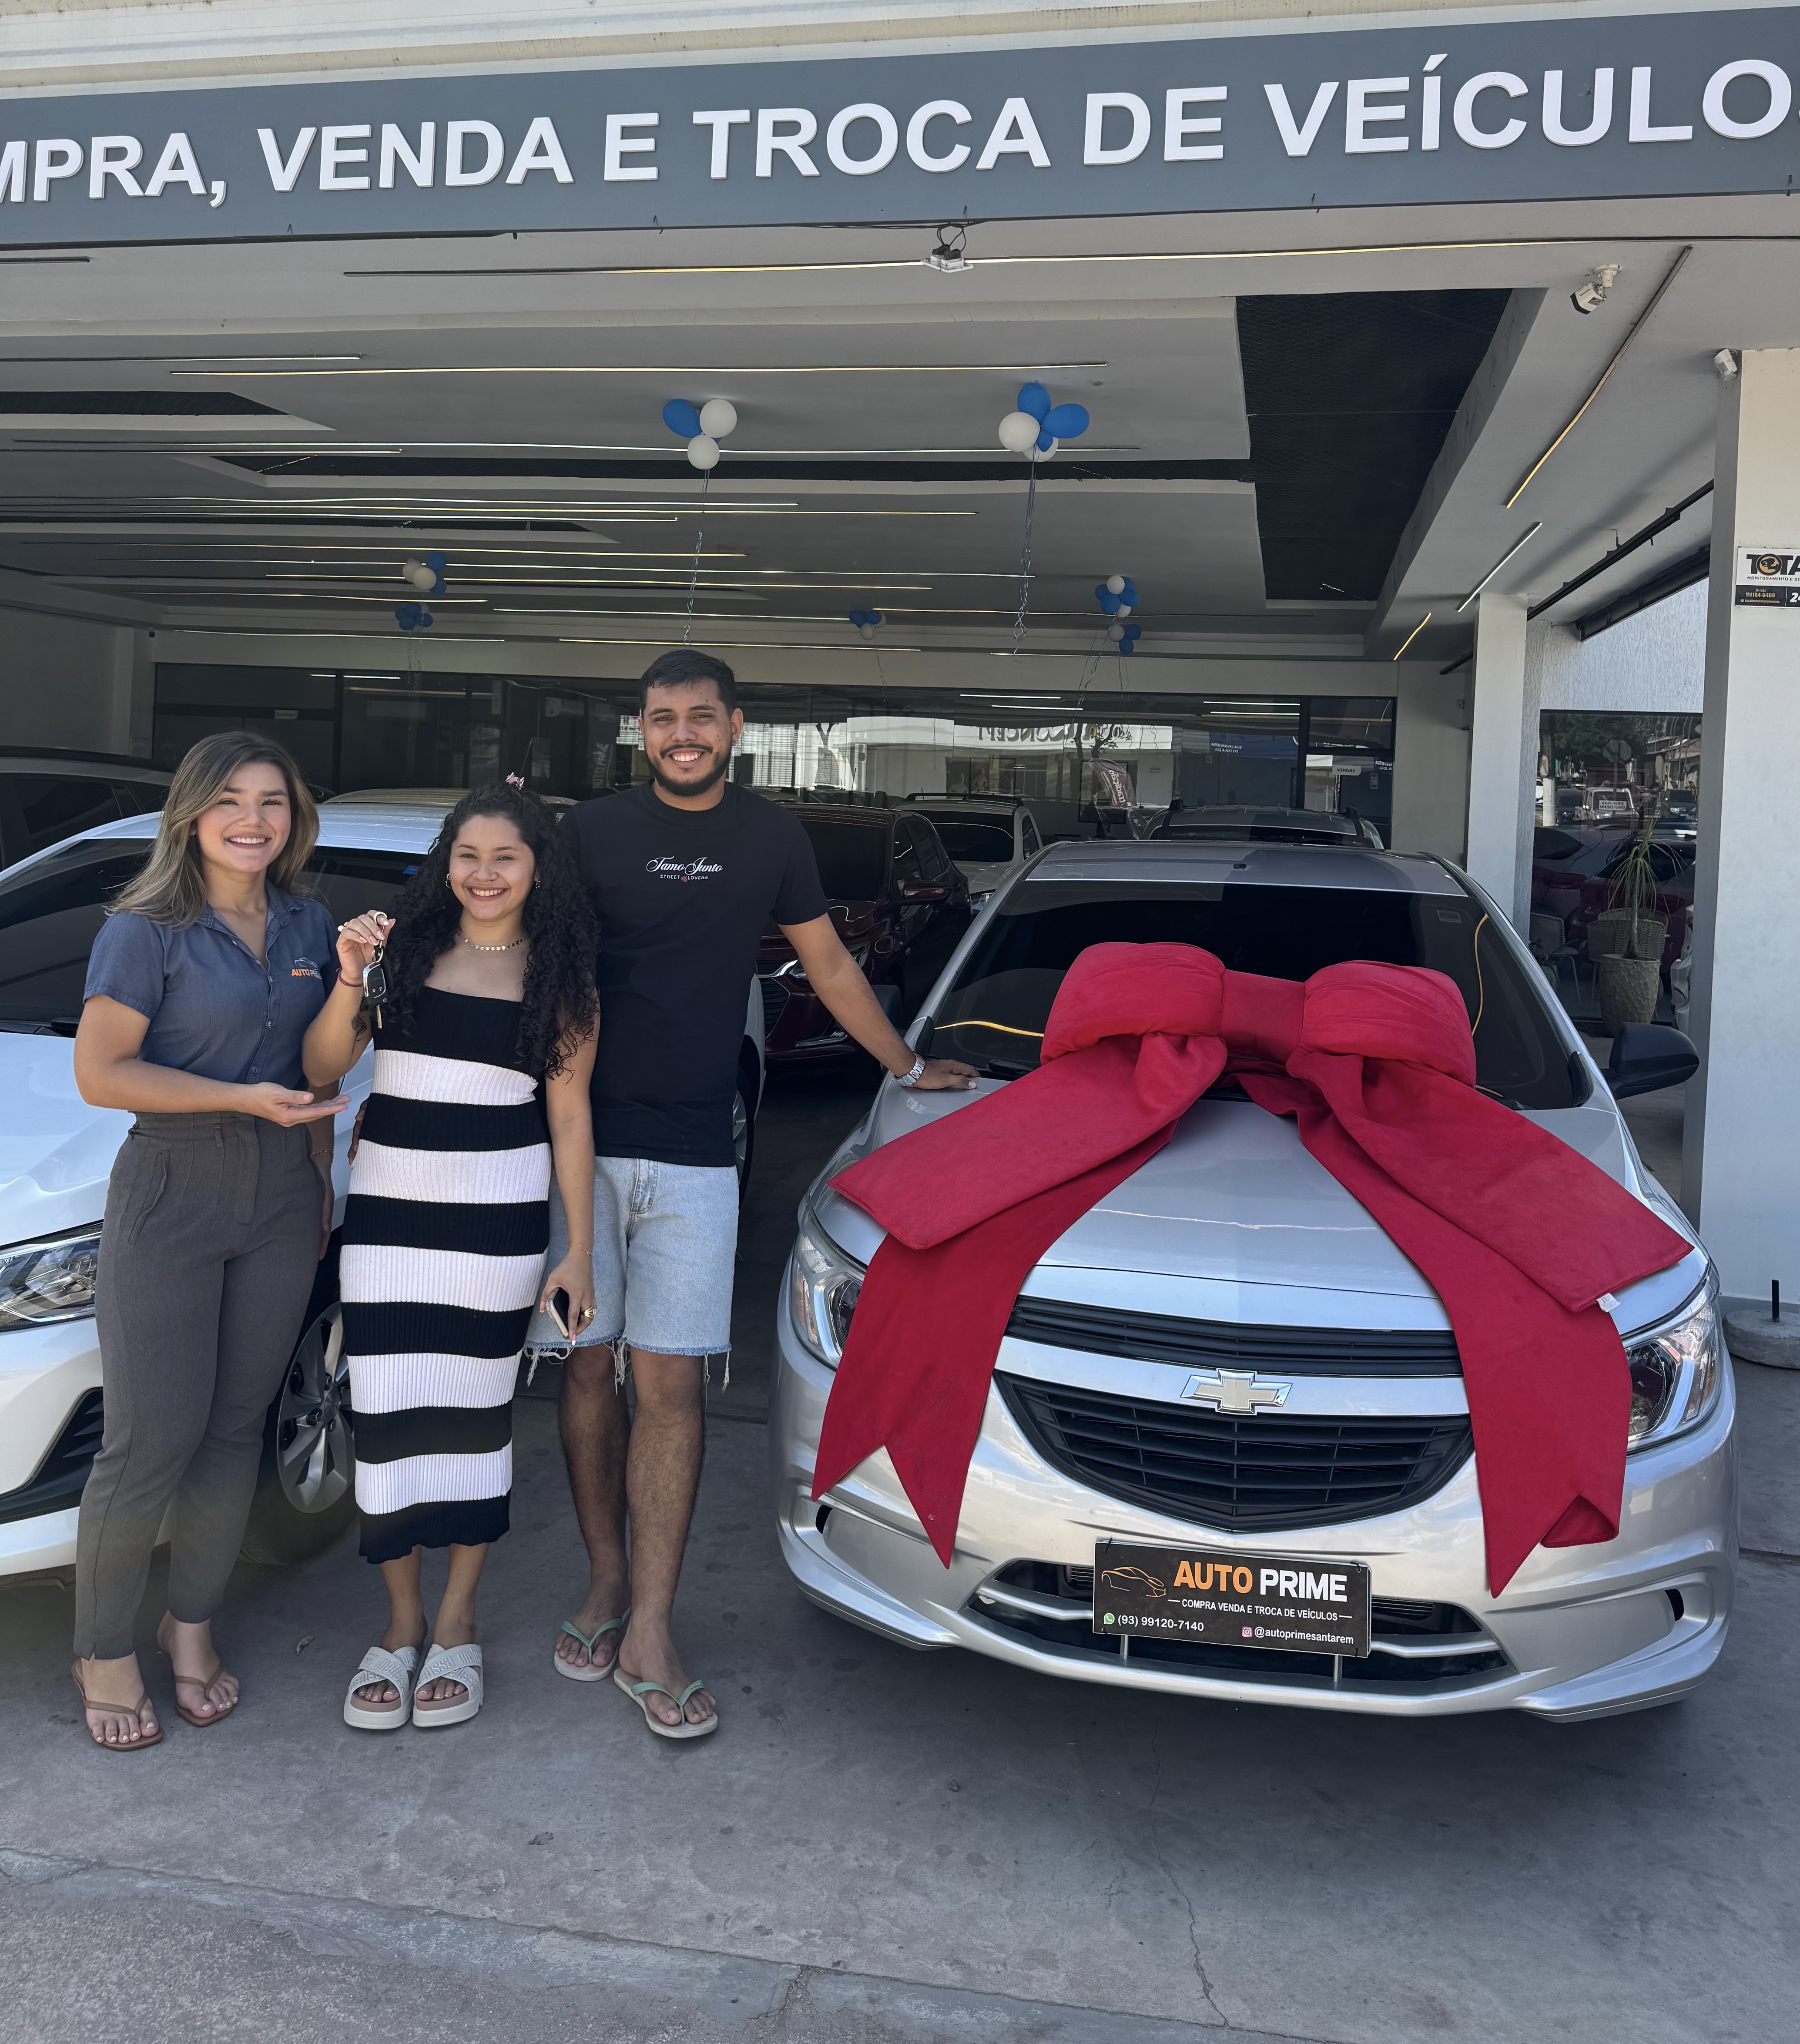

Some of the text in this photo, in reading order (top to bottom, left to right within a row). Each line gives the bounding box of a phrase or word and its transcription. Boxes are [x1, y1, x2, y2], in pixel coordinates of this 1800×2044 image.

[257, 117, 575, 191] VENDA
[603, 112, 660, 182] E
[693, 97, 1052, 177] TROCA
[1083, 86, 1227, 166] DE
[1264, 53, 1800, 157] VEÍCULO
[646, 856, 723, 875] Tamo Junto
[1173, 1560, 1347, 1603] AUTO PRIME
[1181, 1598, 1338, 1621] COMPRA VENDA E TROCA DE VEÍCULOS
[1117, 1615, 1204, 1632] (93) 99120-7140
[1254, 1626, 1354, 1644] @autoprimesantarem
